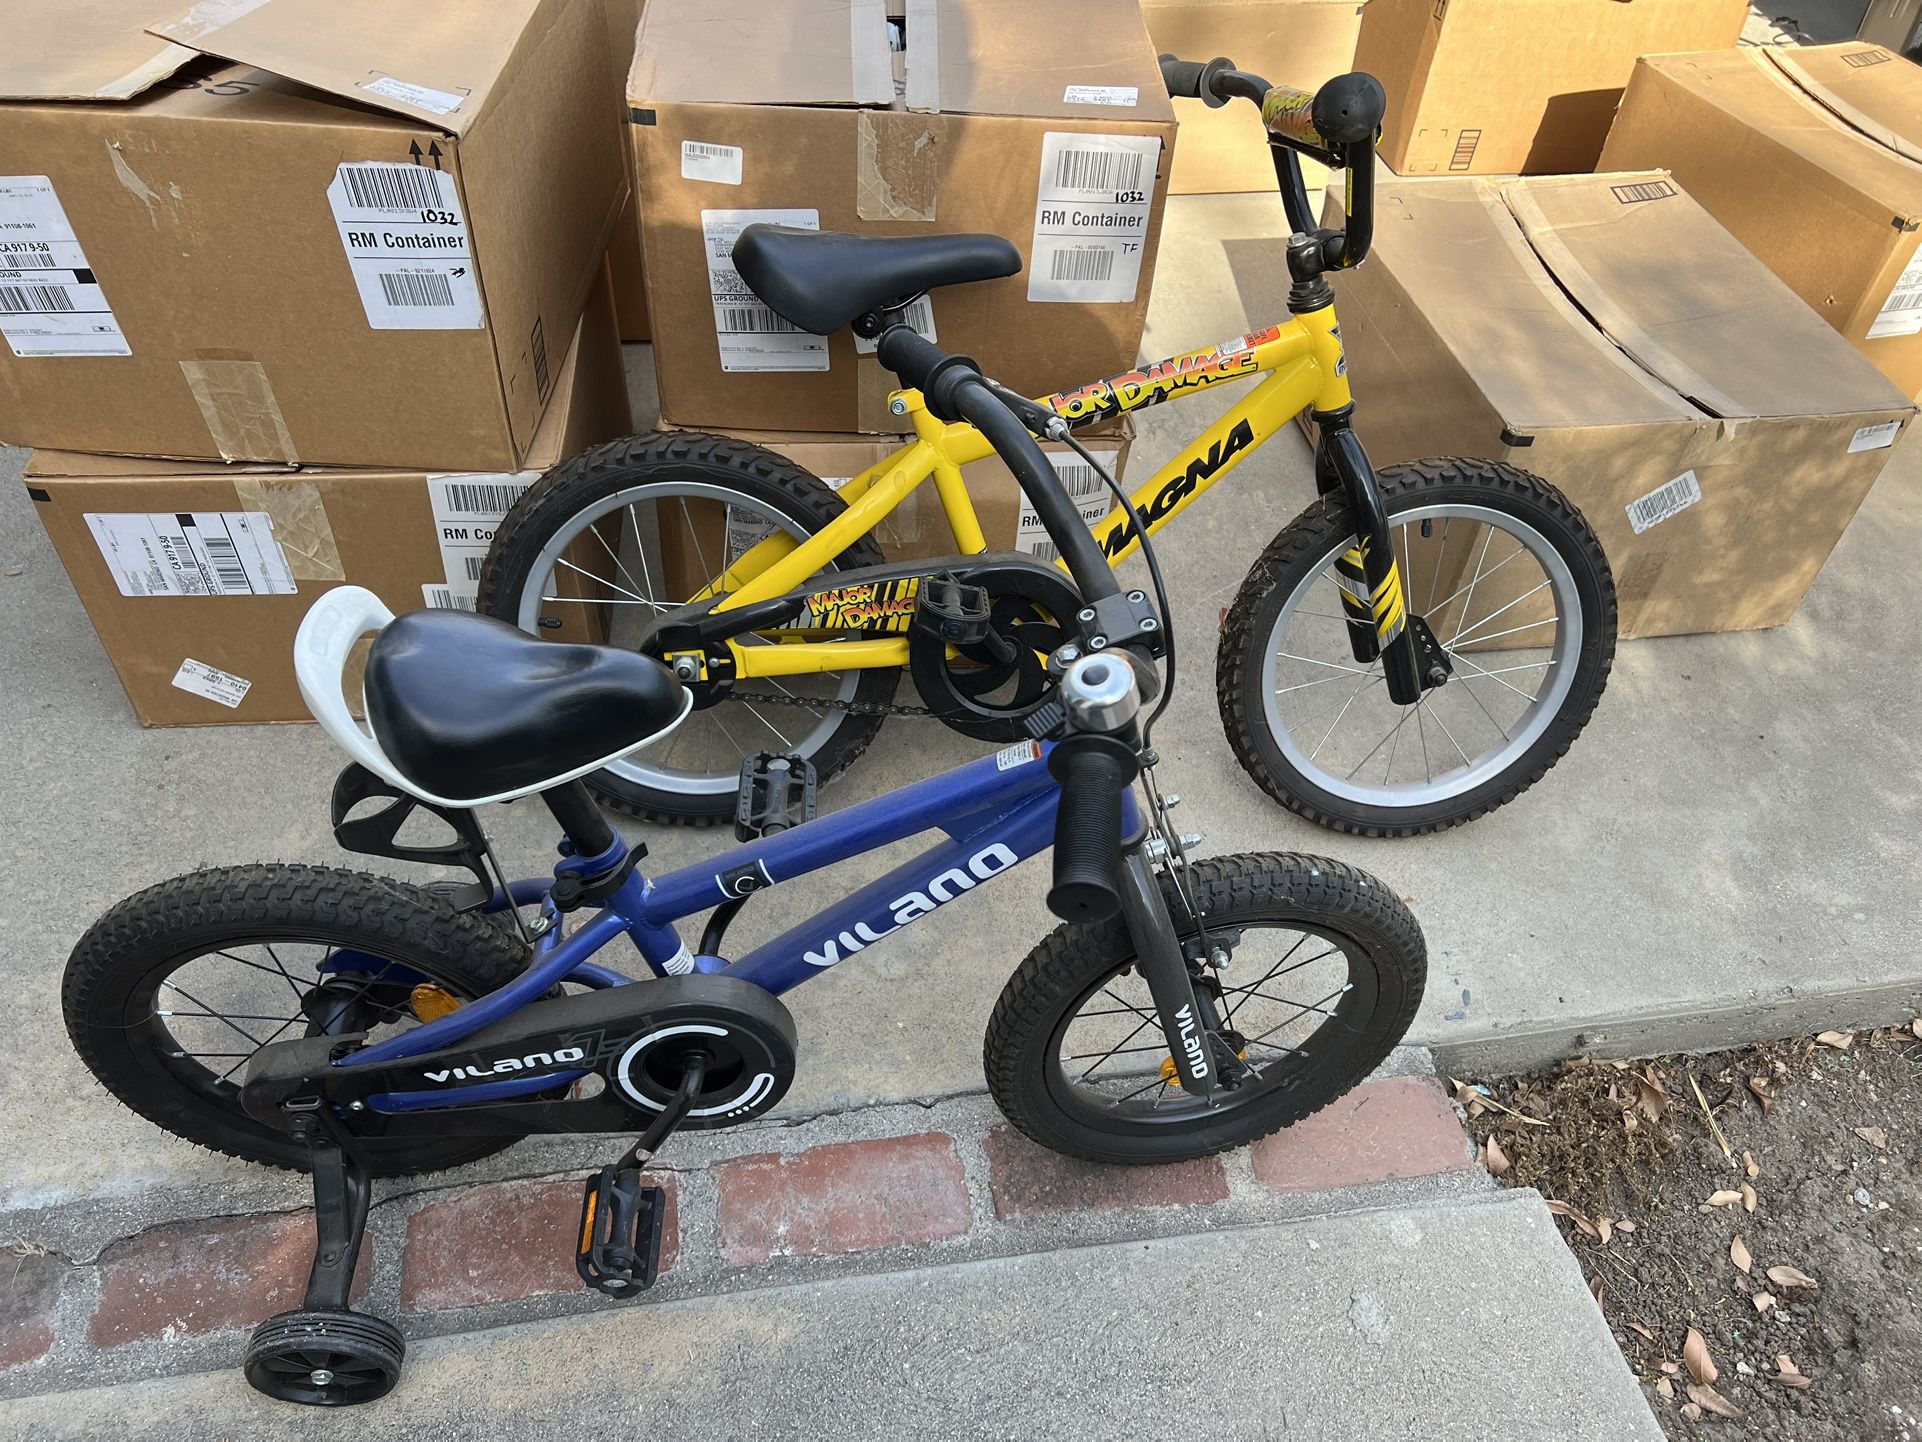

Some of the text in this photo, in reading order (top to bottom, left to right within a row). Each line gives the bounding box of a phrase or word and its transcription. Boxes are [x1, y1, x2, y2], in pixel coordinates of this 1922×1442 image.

[1115, 190, 1145, 203] 1032
[421, 209, 459, 226] 1032
[1041, 210, 1144, 227] RM Container
[347, 232, 464, 248] RM Container
[1121, 243, 1138, 254] TF
[1110, 350, 1259, 413] DAMAGE
[443, 528, 469, 540] RM
[171, 561, 182, 570] CA
[806, 586, 873, 617] MAJOR
[842, 596, 918, 629] DAMAG
